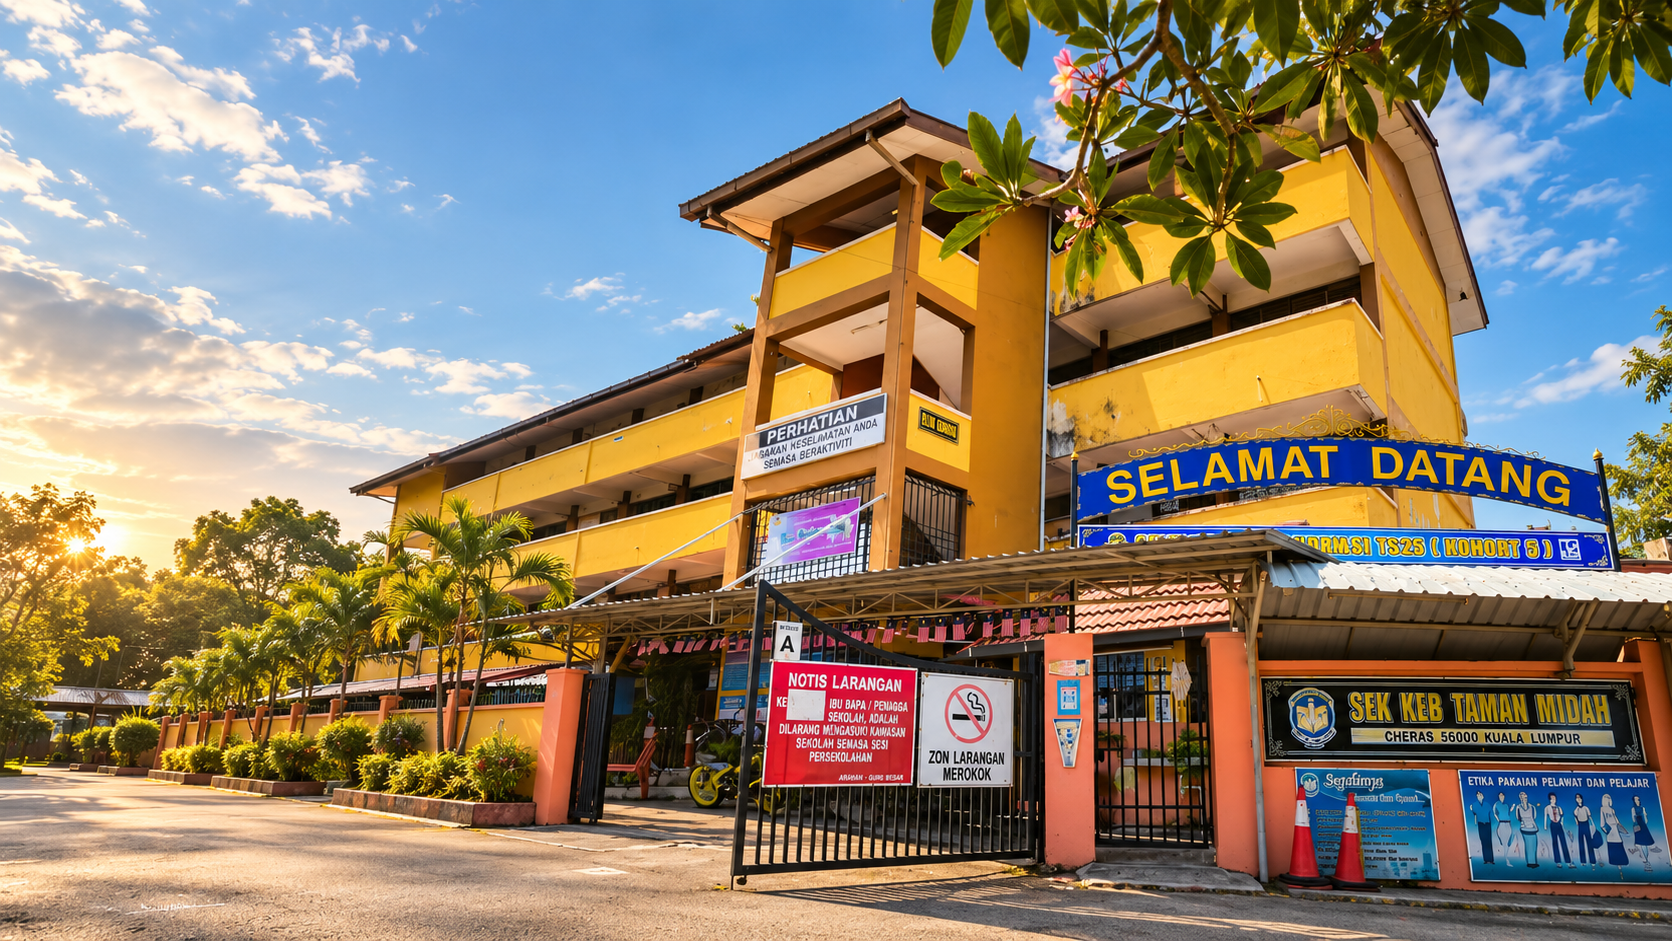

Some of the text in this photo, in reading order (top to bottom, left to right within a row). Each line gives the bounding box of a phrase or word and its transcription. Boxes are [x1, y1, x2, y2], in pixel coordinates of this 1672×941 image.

[766, 405, 858, 445] PERHATIAN
[853, 418, 878, 433] ANDA
[763, 437, 853, 470] SEMASA BERAKTIVITI
[1106, 445, 1571, 507] SELAMAT DATANG
[1375, 536, 1425, 556] TS25
[1443, 538, 1520, 558] KOHORT
[779, 635, 795, 653] A
[788, 672, 902, 692] NOTIS LARANGAN
[829, 698, 843, 710] IBU
[845, 699, 866, 711] BAPA
[1348, 691, 1394, 724] SEK
[1399, 692, 1444, 724] KEB
[1450, 693, 1529, 725] TAMAN
[1534, 694, 1612, 726] MIDAH
[827, 711, 899, 725] SEKOLAH, ADALAH
[795, 737, 834, 749] SEKOLAH
[1384, 730, 1582, 745] CHERAS 56000 KUALA LUMPUR
[808, 751, 873, 763] PERSEKOLAHAN
[928, 750, 1005, 765] ZON LARANGAN
[942, 767, 992, 781] MEROKOK
[1468, 776, 1650, 789] ETIKA PAKAIAN PELAWAT DAN PELAJAR
